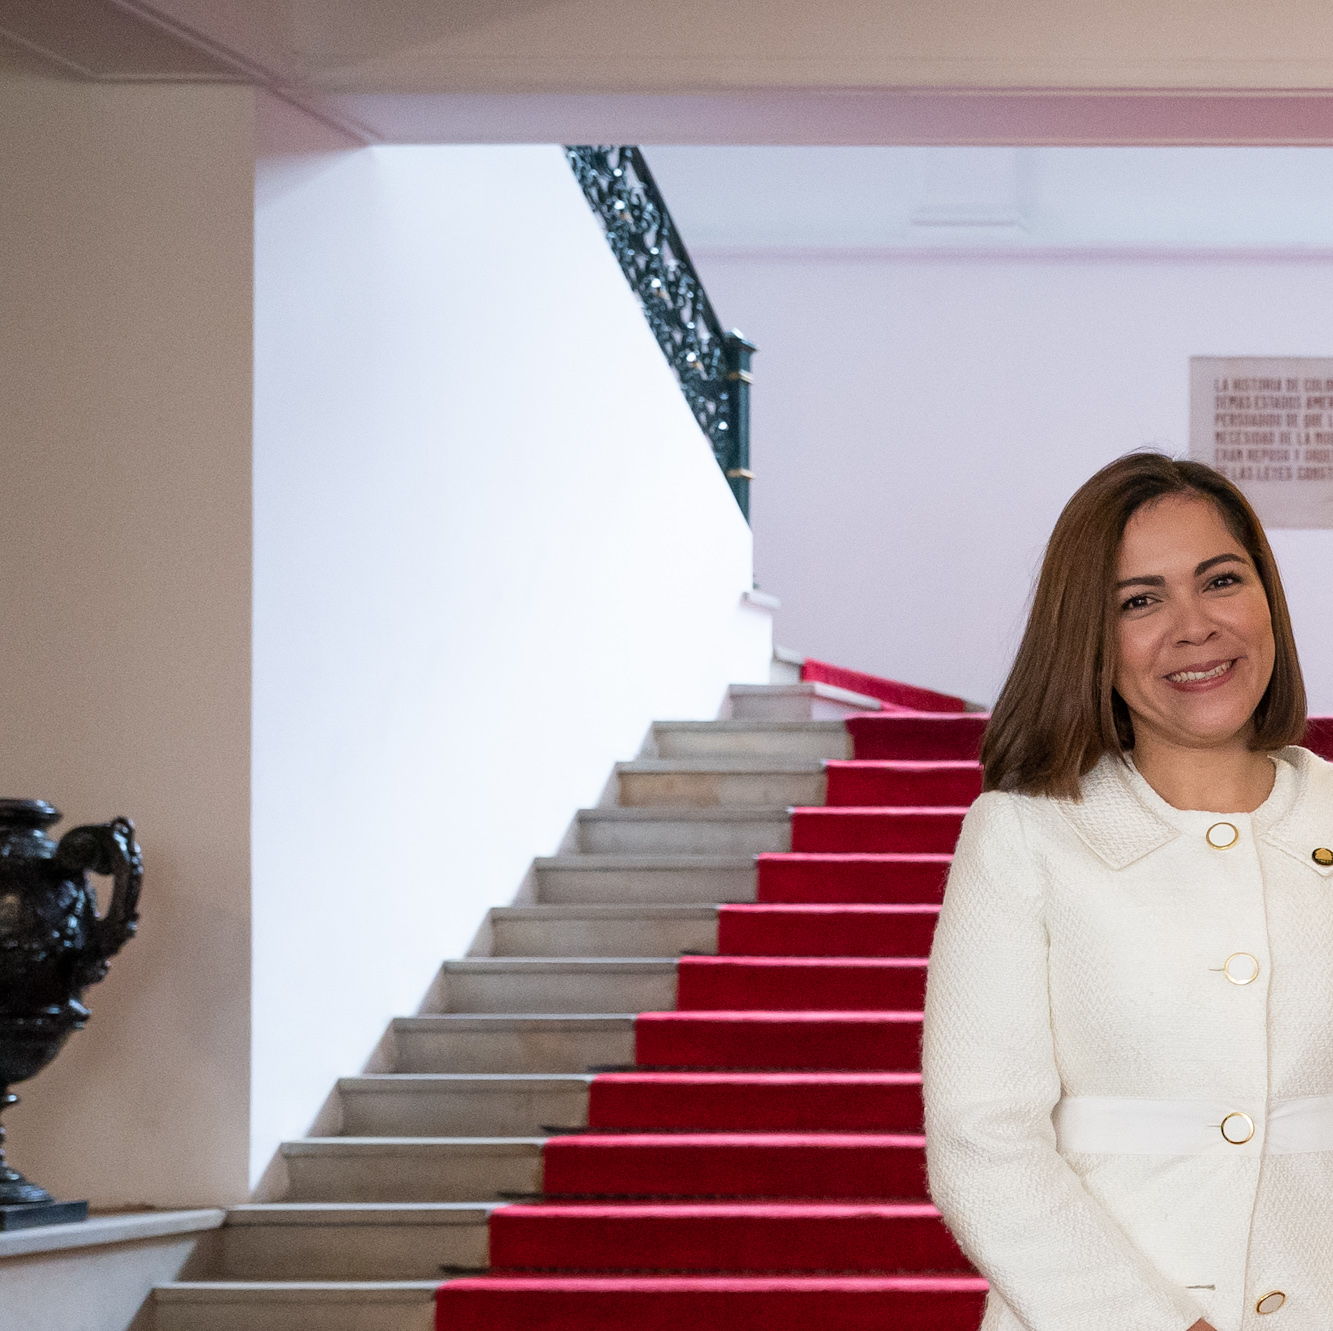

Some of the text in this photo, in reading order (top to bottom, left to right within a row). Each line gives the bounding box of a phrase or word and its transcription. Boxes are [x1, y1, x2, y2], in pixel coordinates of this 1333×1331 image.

[1214, 379, 1228, 392] LA
[1233, 379, 1281, 392] HISTORIA
[1286, 379, 1298, 392] DE
[1215, 396, 1250, 410] DEMAS
[1254, 396, 1301, 410] ESTADOS
[1215, 413, 1281, 427] PERSUADIDO
[1286, 413, 1298, 427] DE
[1304, 413, 1322, 427] QUE
[1215, 431, 1274, 445] NECESIDAD
[1280, 431, 1291, 445] DE
[1297, 431, 1310, 445] LA
[1215, 449, 1243, 463] ERAN
[1248, 449, 1290, 463] REPOSO
[1232, 466, 1253, 480] LAS
[1257, 466, 1292, 480] LEYES
